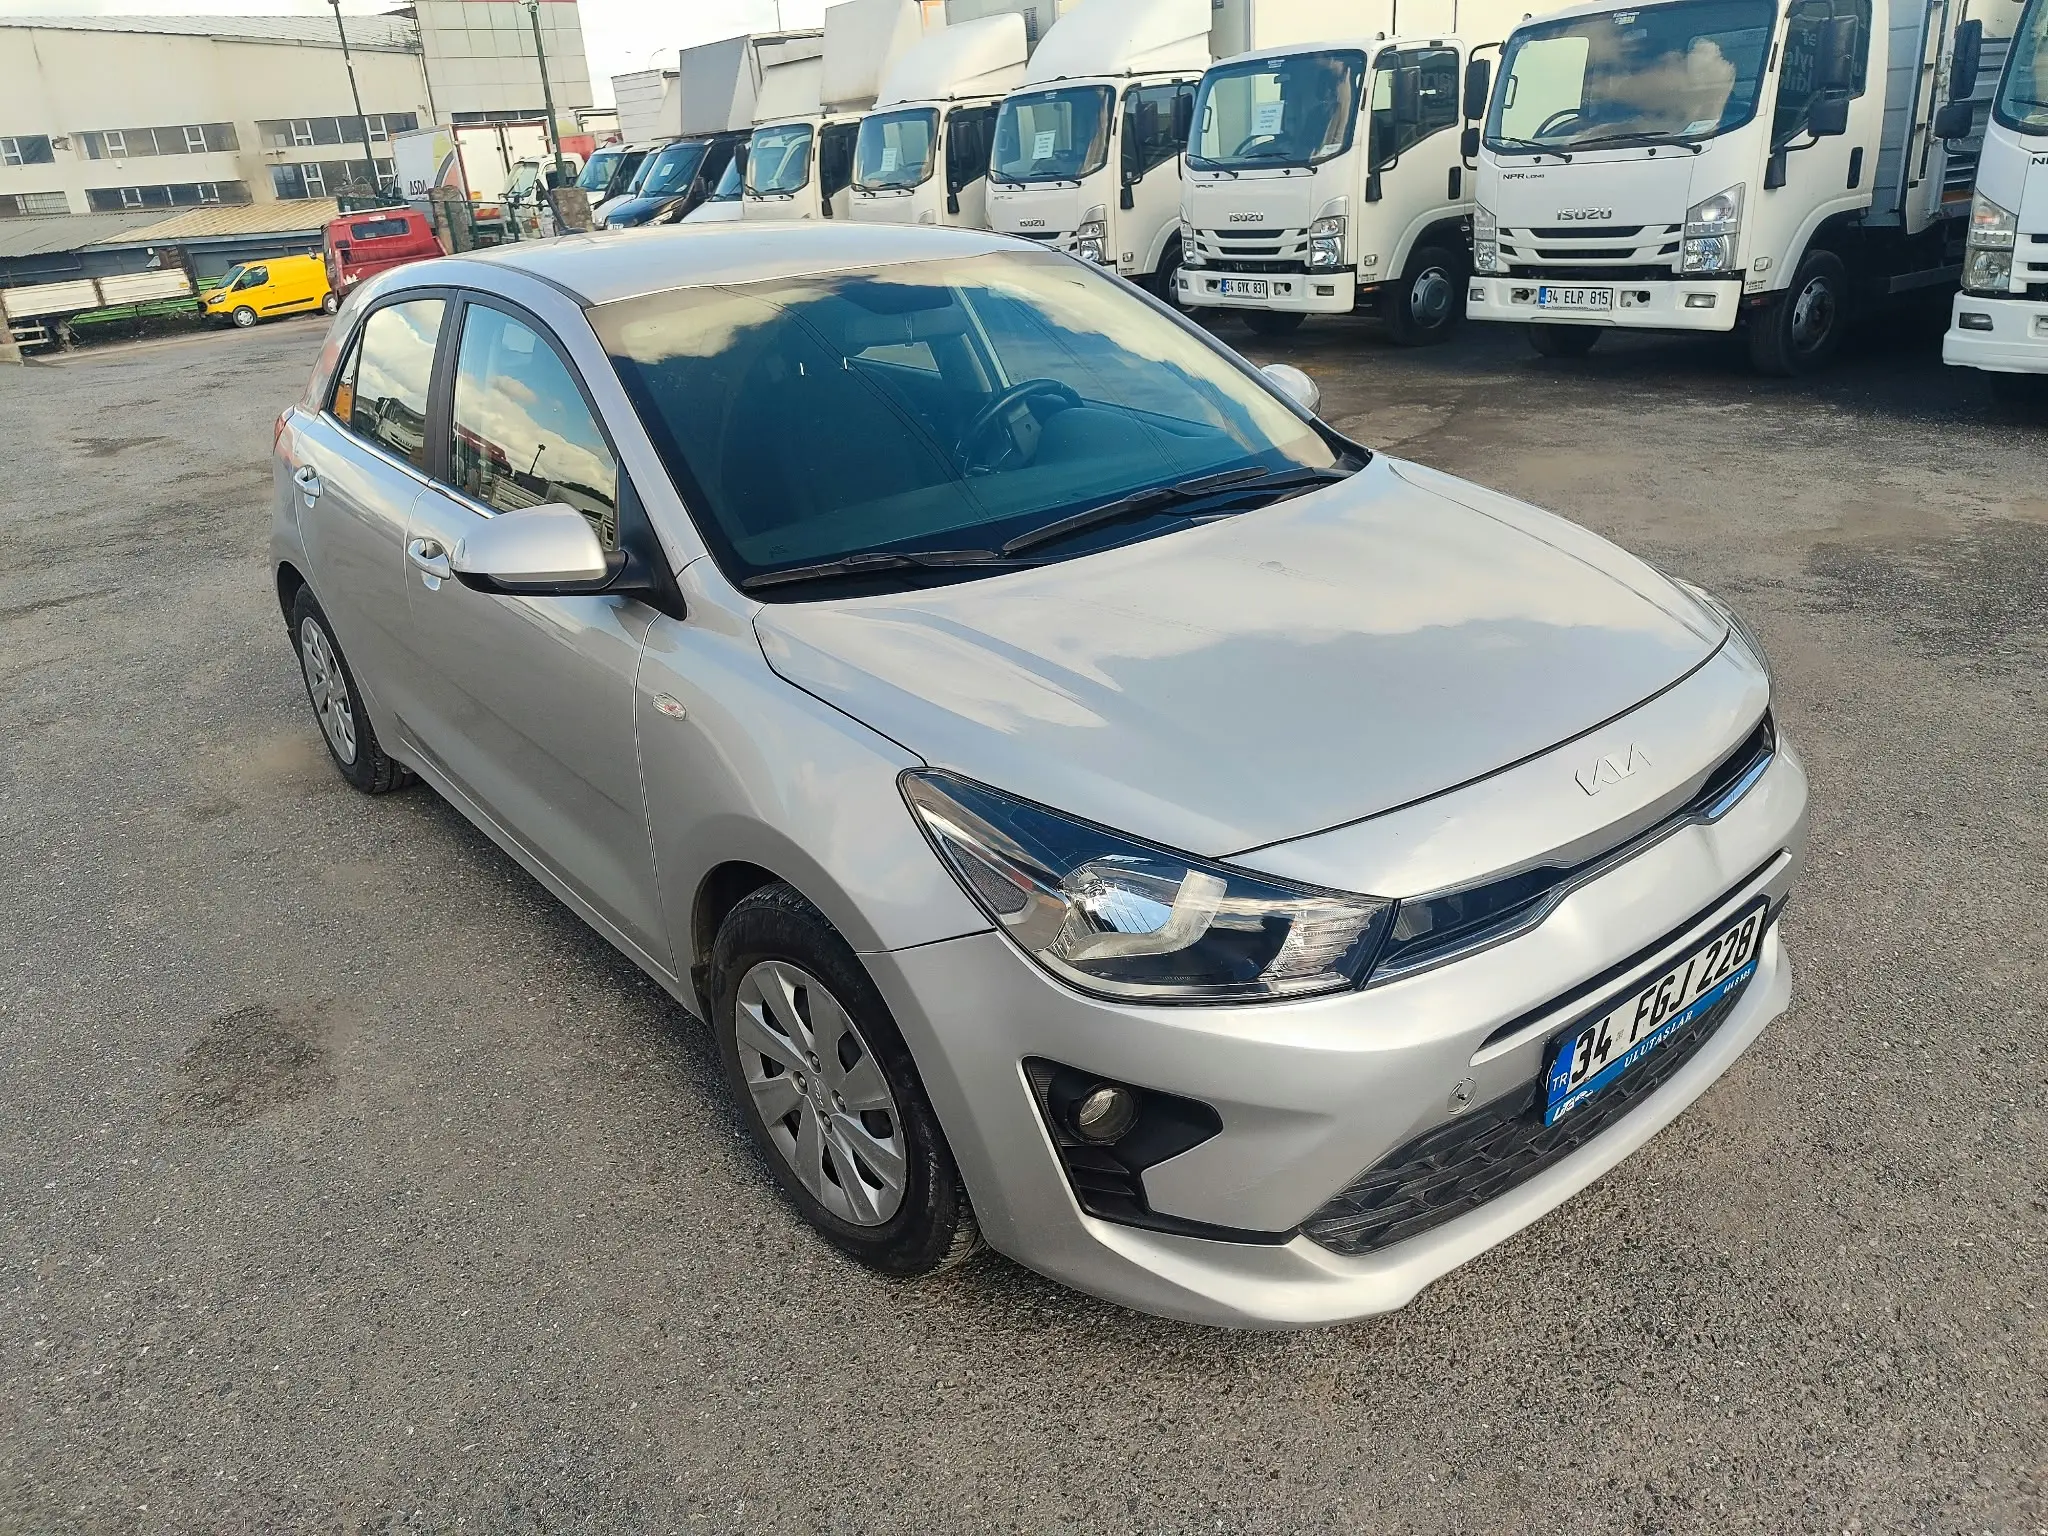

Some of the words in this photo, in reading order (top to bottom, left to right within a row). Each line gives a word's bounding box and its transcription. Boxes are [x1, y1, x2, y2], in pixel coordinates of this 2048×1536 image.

[2031, 157, 2048, 165] N
[1229, 211, 1264, 222] ISUZU
[1556, 207, 1613, 221] ISUZU
[1253, 282, 1265, 294] 831
[1546, 289, 1559, 304] 34
[1564, 290, 1584, 305] ELR
[1590, 290, 1609, 305] 815
[1571, 1016, 1613, 1085] 34
[1629, 959, 1696, 1044] FGJ
[1695, 915, 1756, 995] 228
[1552, 1071, 1569, 1092] TR
